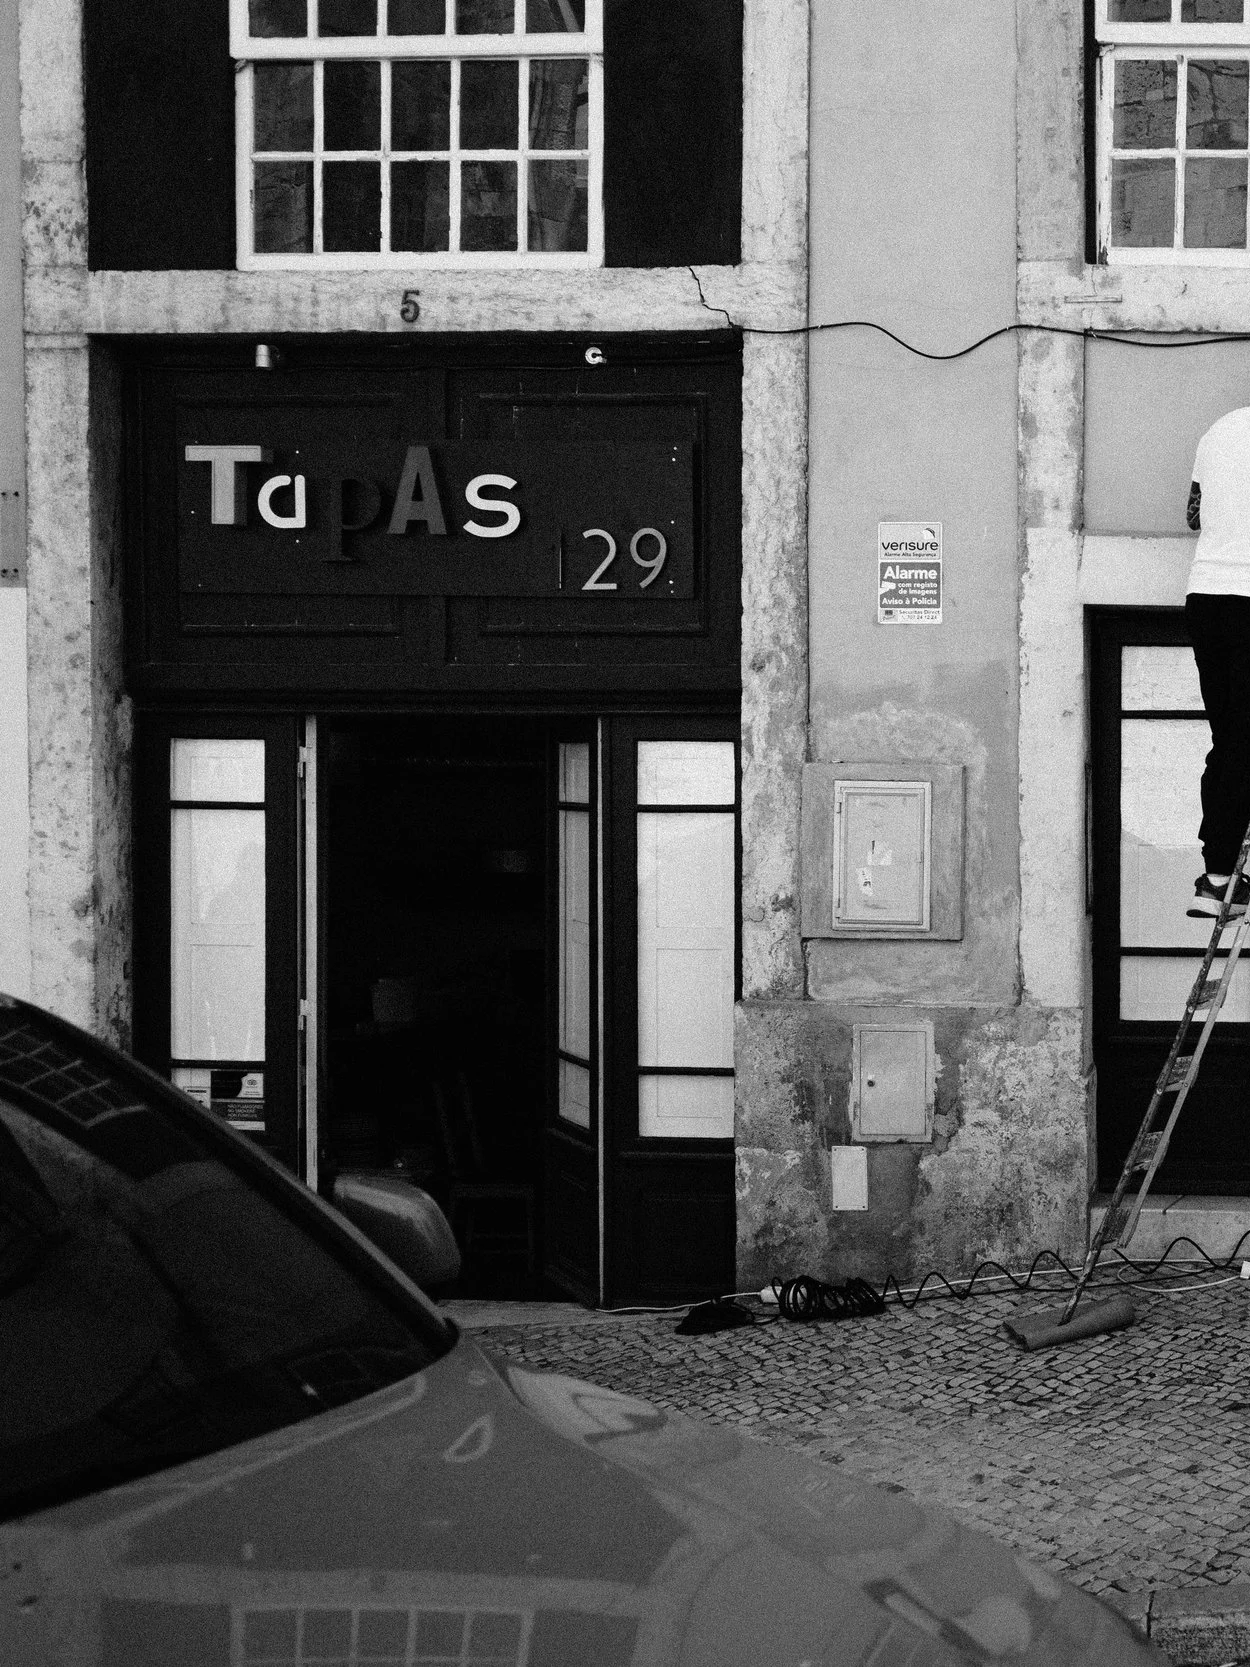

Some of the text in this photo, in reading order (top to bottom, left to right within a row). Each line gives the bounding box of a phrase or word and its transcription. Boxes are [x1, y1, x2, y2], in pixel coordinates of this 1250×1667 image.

[400, 289, 420, 323] 5
[881, 541, 939, 551] verisure
[883, 565, 938, 580] Alarme
[913, 581, 938, 589] registo
[882, 597, 904, 605] Aviso
[905, 597, 911, 605] à
